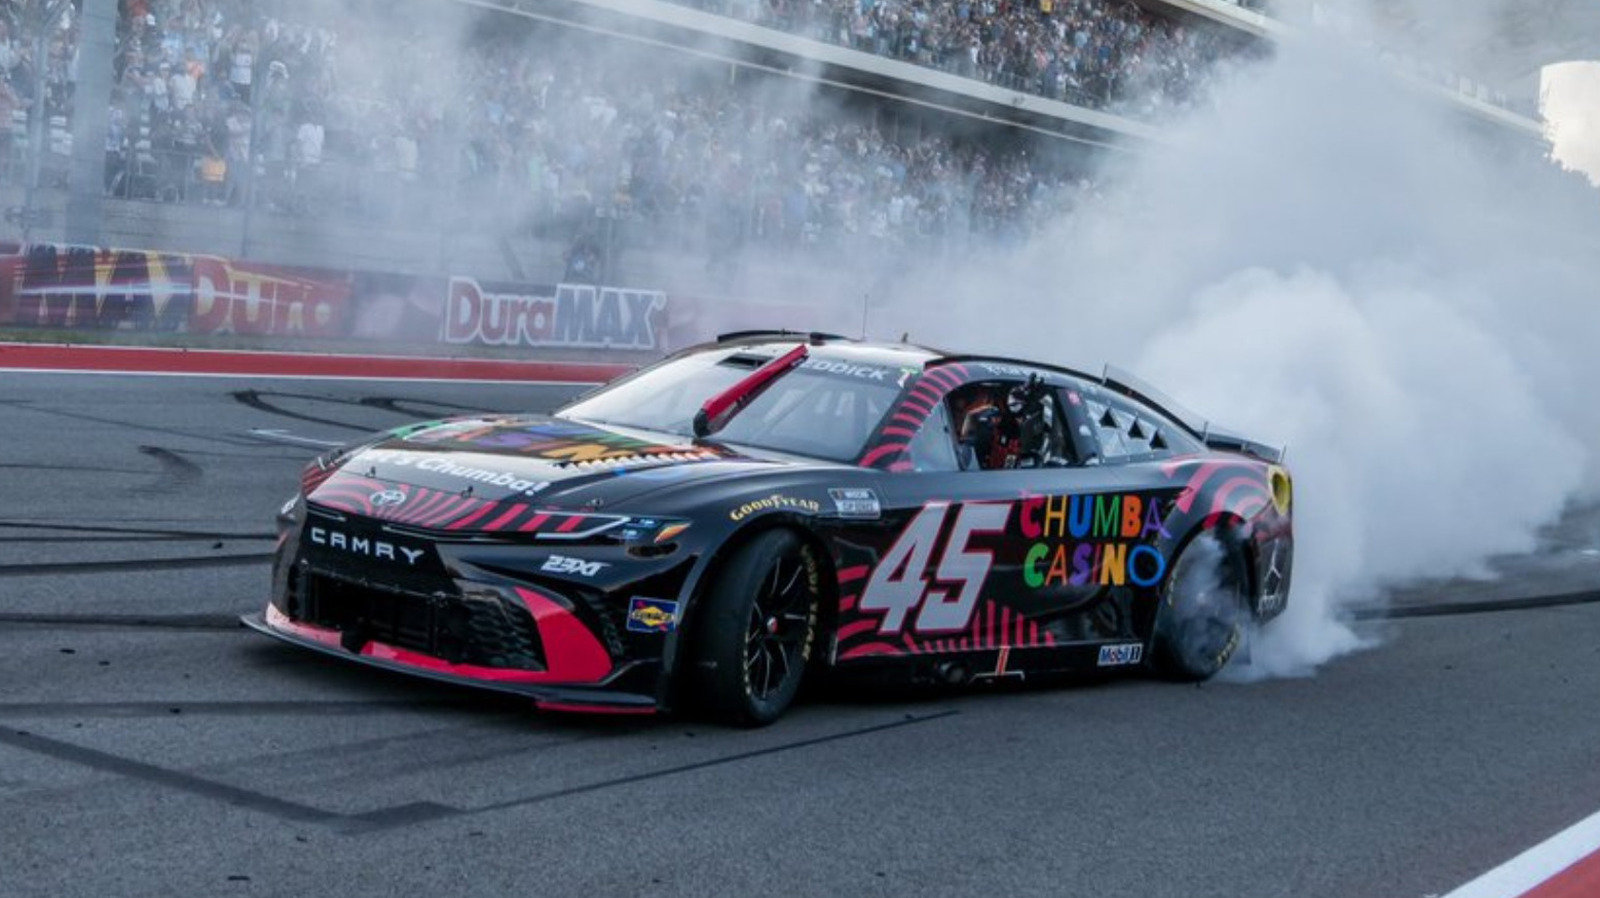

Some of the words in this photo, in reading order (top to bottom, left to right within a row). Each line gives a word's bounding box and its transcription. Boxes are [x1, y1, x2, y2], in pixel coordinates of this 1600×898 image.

[446, 276, 663, 349] DuraMAX
[791, 358, 889, 381] EDDICK
[415, 456, 551, 497] Chumba!
[730, 494, 820, 521] GOODYEAR
[1019, 491, 1171, 539] CHUMBA
[310, 526, 425, 565] CAMRY
[1023, 542, 1166, 588] CASINO
[860, 500, 1013, 635] 45
